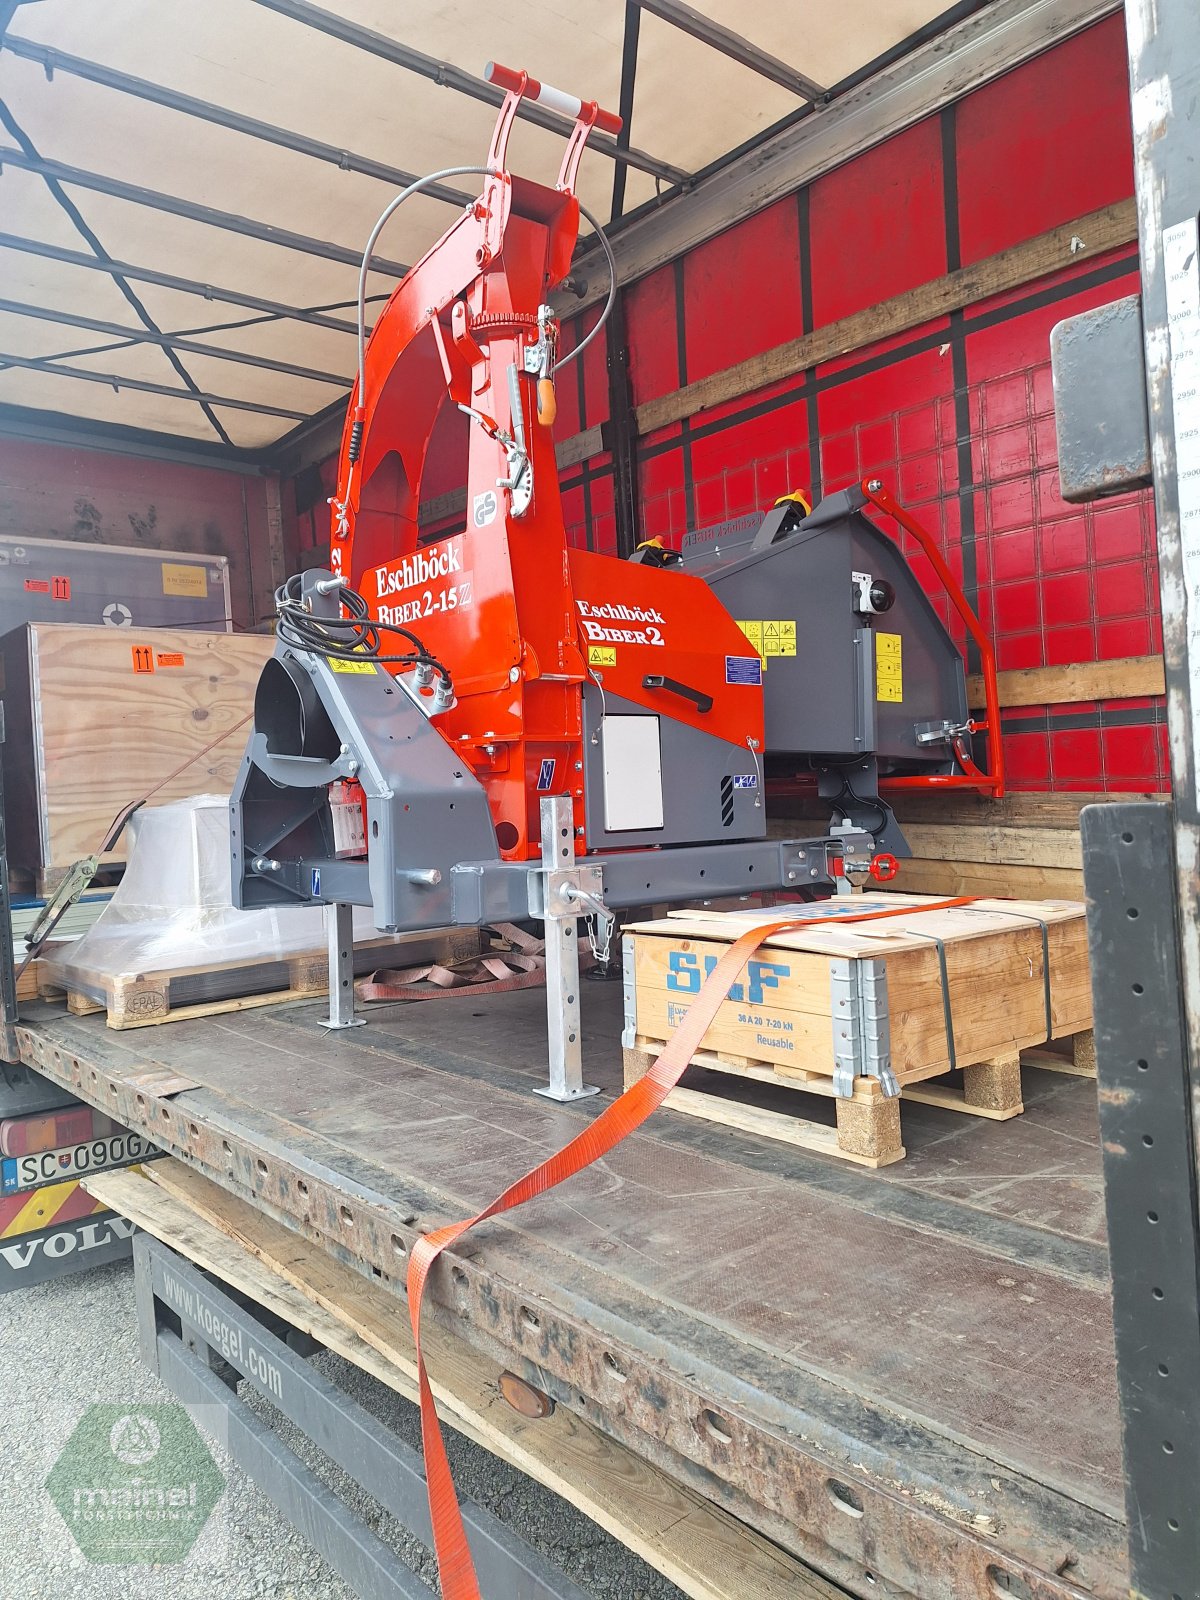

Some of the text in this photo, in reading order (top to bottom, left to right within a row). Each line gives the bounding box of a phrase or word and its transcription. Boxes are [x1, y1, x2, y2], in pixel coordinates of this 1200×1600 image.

[1172, 309, 1192, 322] 3000
[1175, 349, 1194, 361] 2975
[1177, 388, 1196, 401] 2950
[1179, 427, 1199, 440] 2925
[1186, 550, 1200, 559] 285
[375, 542, 461, 598] Eschlböck
[575, 599, 666, 624] Eschlböck
[132, 995, 159, 1010] EPAL
[747, 1015, 754, 1025] A
[754, 1016, 763, 1026] 20
[766, 1018, 782, 1029] 7-20
[783, 1021, 794, 1032] kN
[757, 1033, 794, 1051] Reusable
[21, 1153, 56, 1183] SC
[4, 1178, 16, 1187] SK
[0, 1216, 138, 1270] VOLV
[163, 1272, 283, 1399] www.koegel.com
